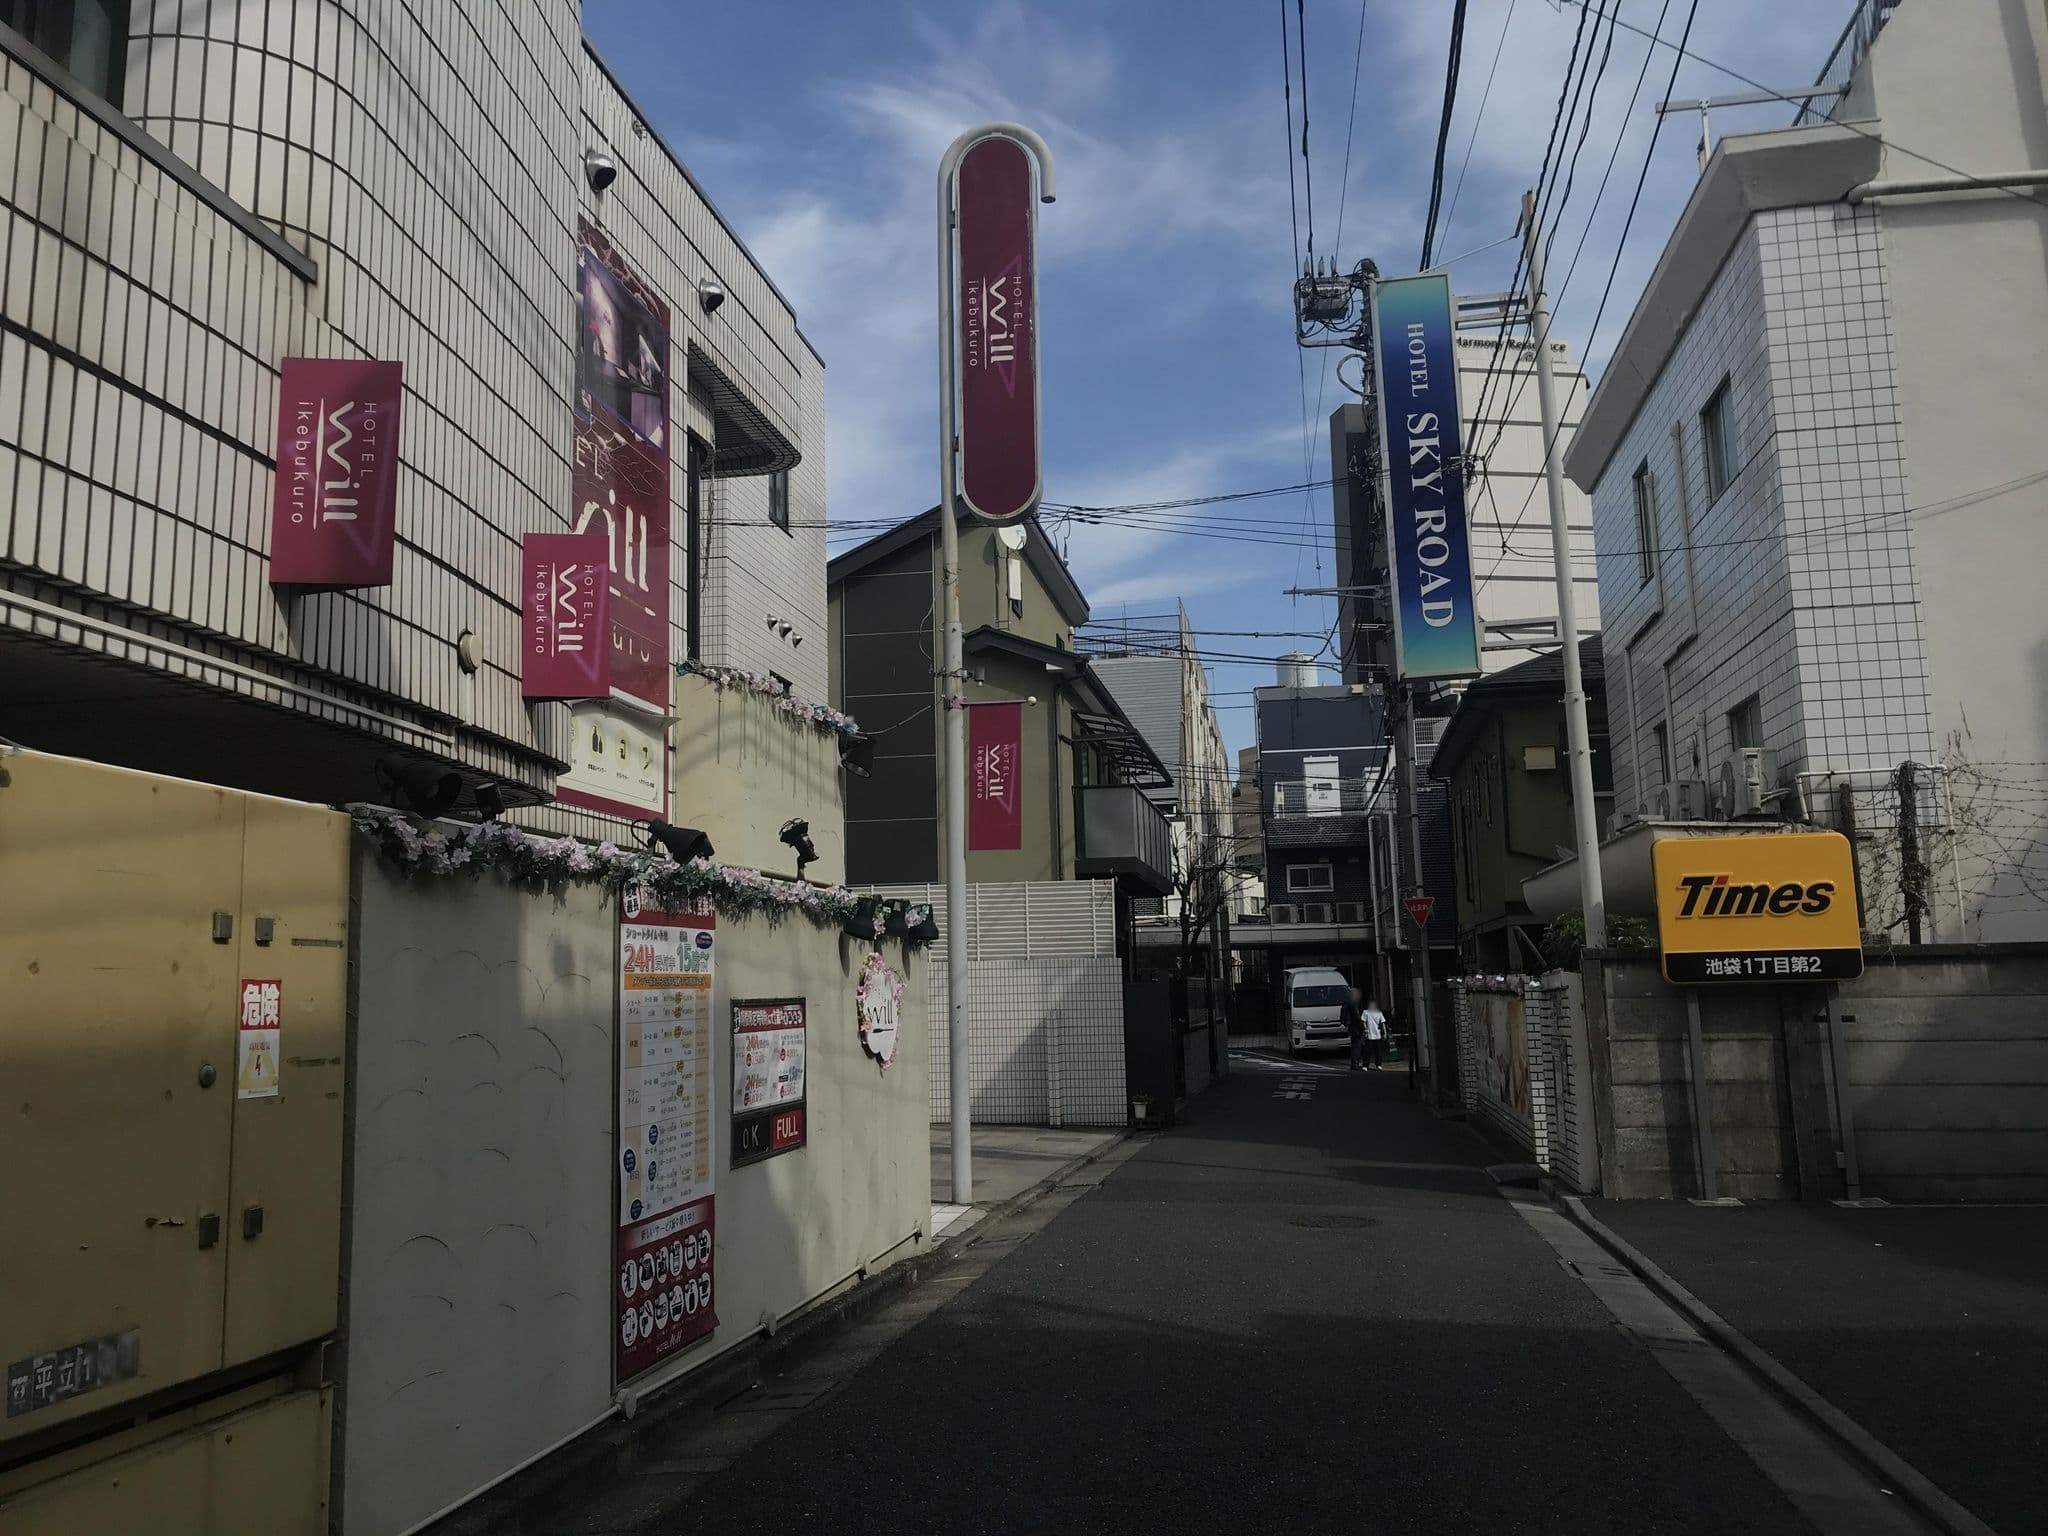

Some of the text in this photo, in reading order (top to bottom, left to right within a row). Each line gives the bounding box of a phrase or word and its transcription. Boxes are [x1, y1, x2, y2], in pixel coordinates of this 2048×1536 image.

[968, 280, 979, 367] ikebukuro
[1013, 276, 1023, 330] HOTEL
[291, 401, 313, 524] ikebukuro
[361, 402, 377, 477] HOTEL
[1407, 322, 1454, 628] HOTEL SKY ROAD
[536, 564, 548, 654] ikebukuro
[583, 564, 594, 620] HOTEL
[977, 745, 985, 799] ikebukuro
[1679, 875, 1835, 916] Times
[1705, 955, 1823, 976] 池袋1丁目第2
[241, 983, 280, 1026] 危険
[742, 1125, 759, 1149] OK
[776, 1117, 799, 1140] FULL
